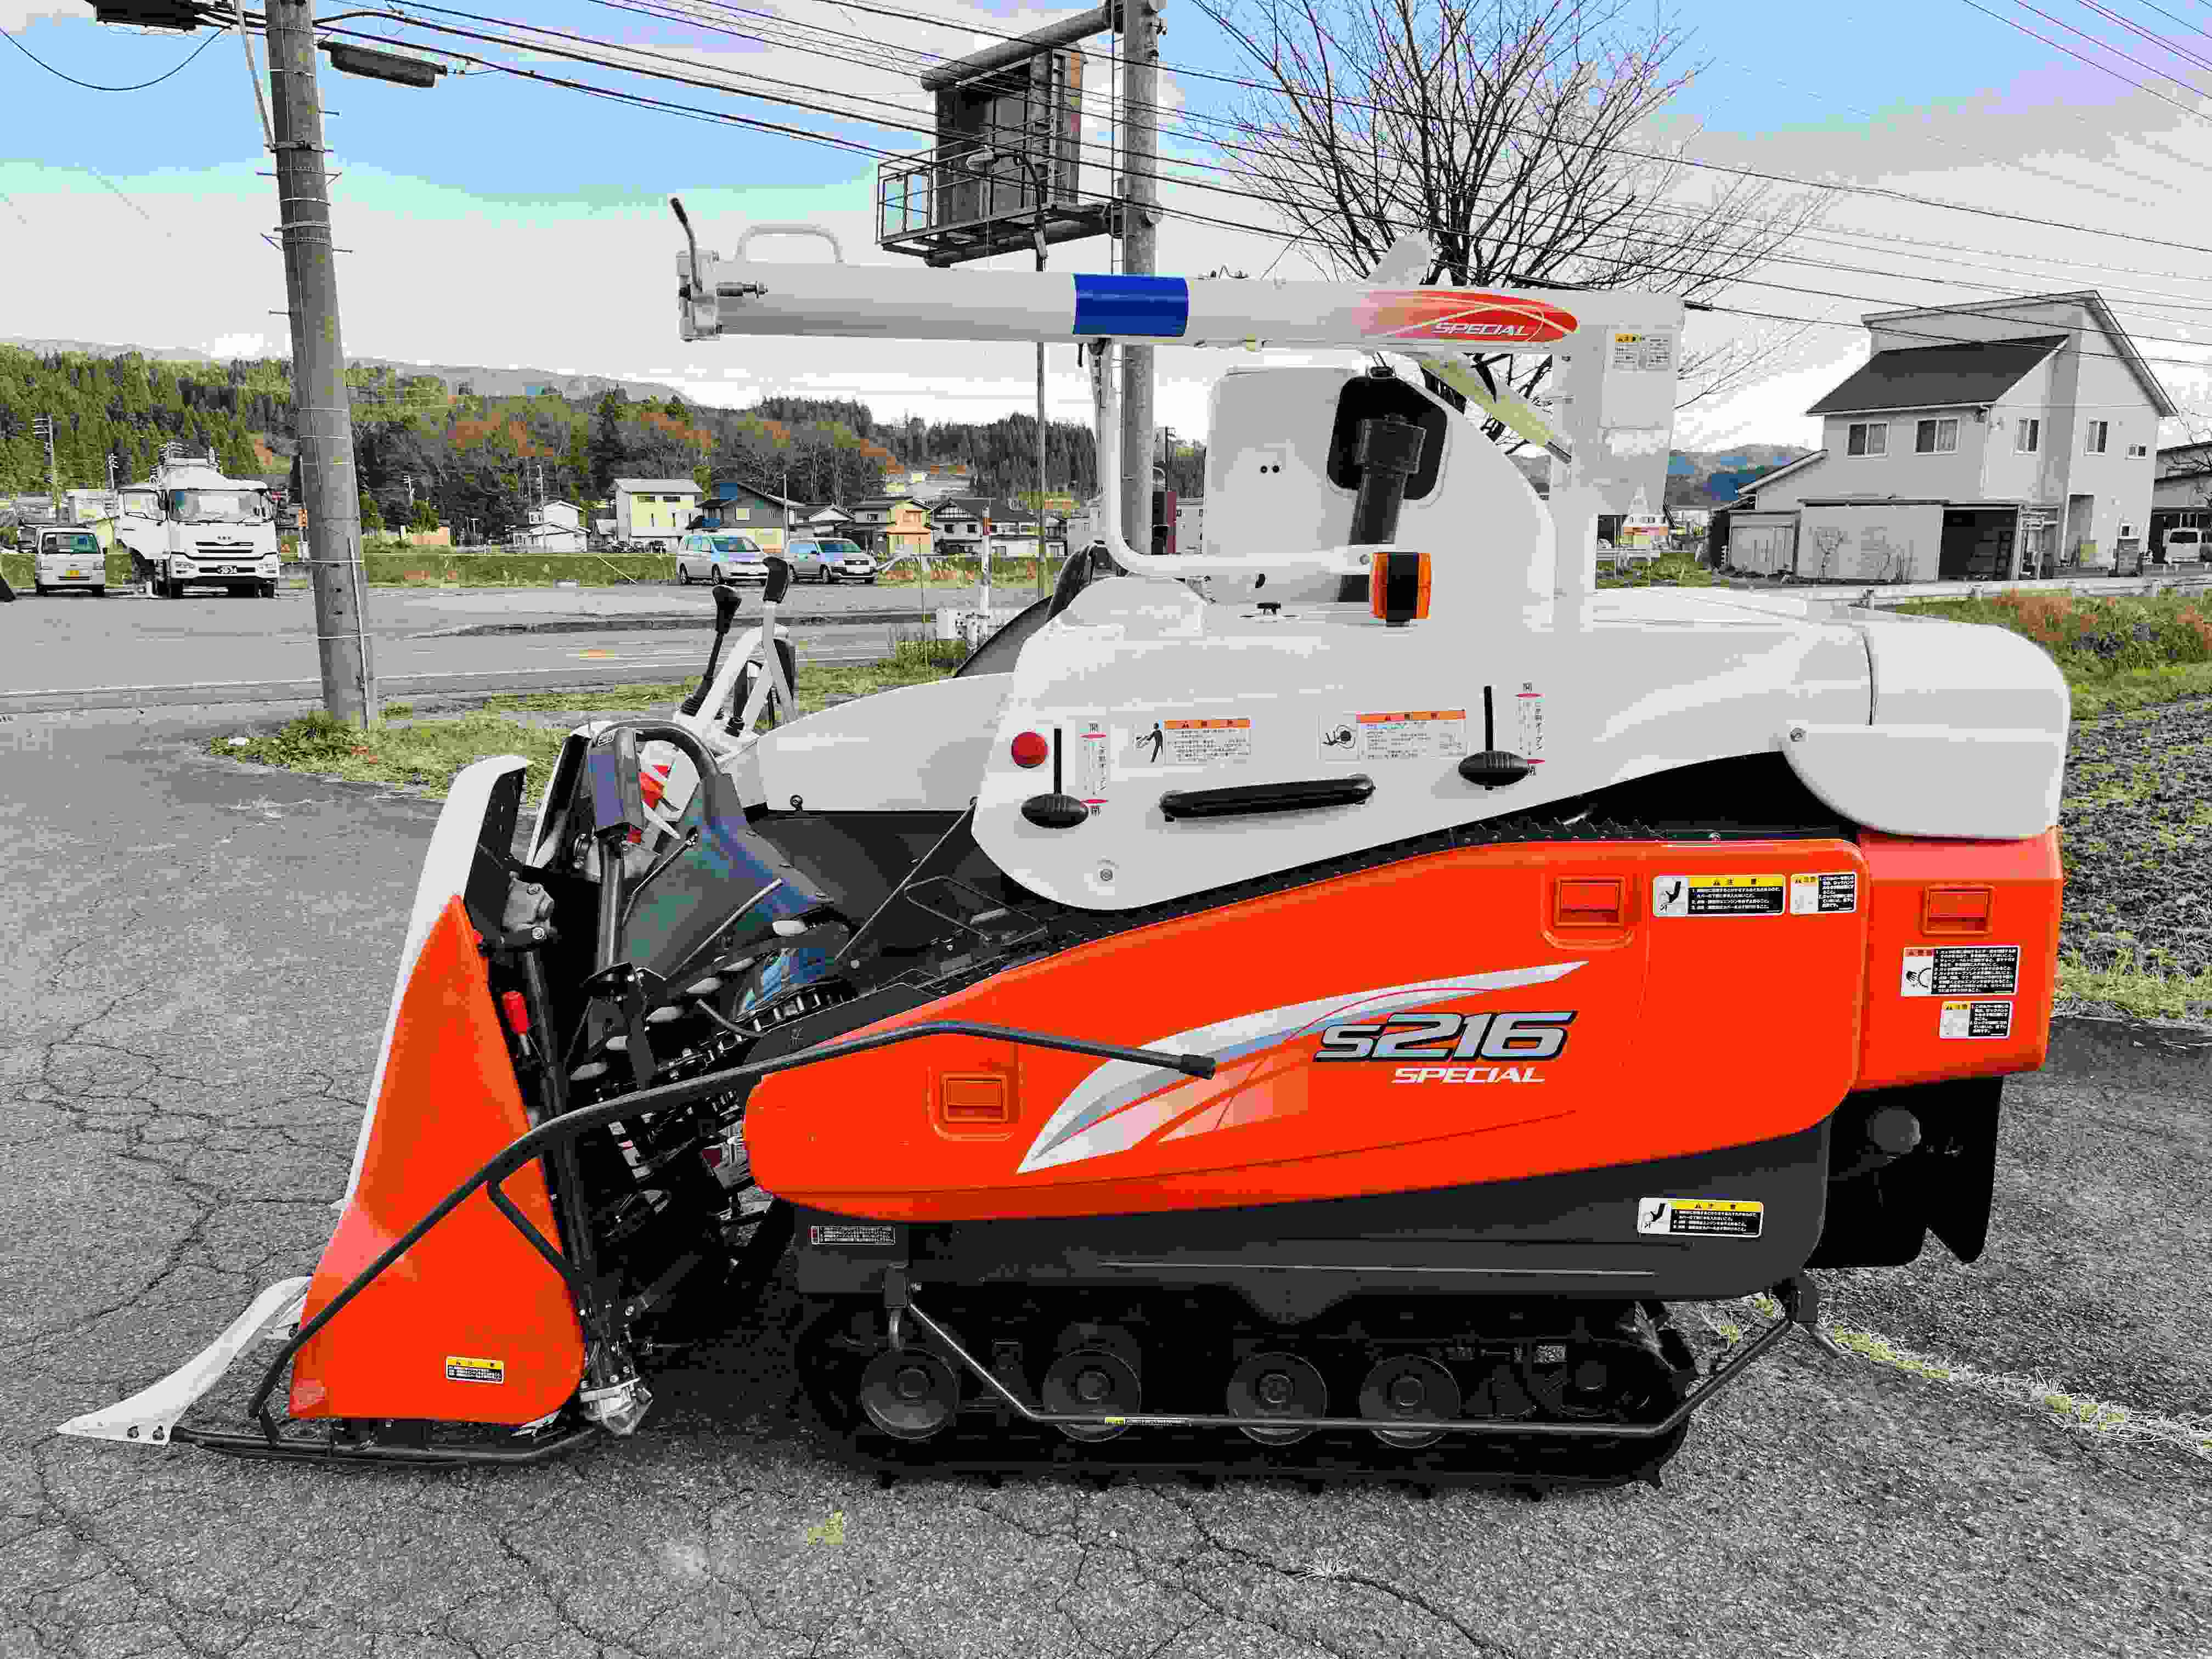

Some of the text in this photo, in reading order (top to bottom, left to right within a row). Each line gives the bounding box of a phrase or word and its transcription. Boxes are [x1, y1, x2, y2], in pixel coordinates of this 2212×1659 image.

[1432, 323, 1530, 336] SPECIAL
[1314, 1011, 1577, 1062] S216
[1393, 1067, 1545, 1084] SPECIAL
